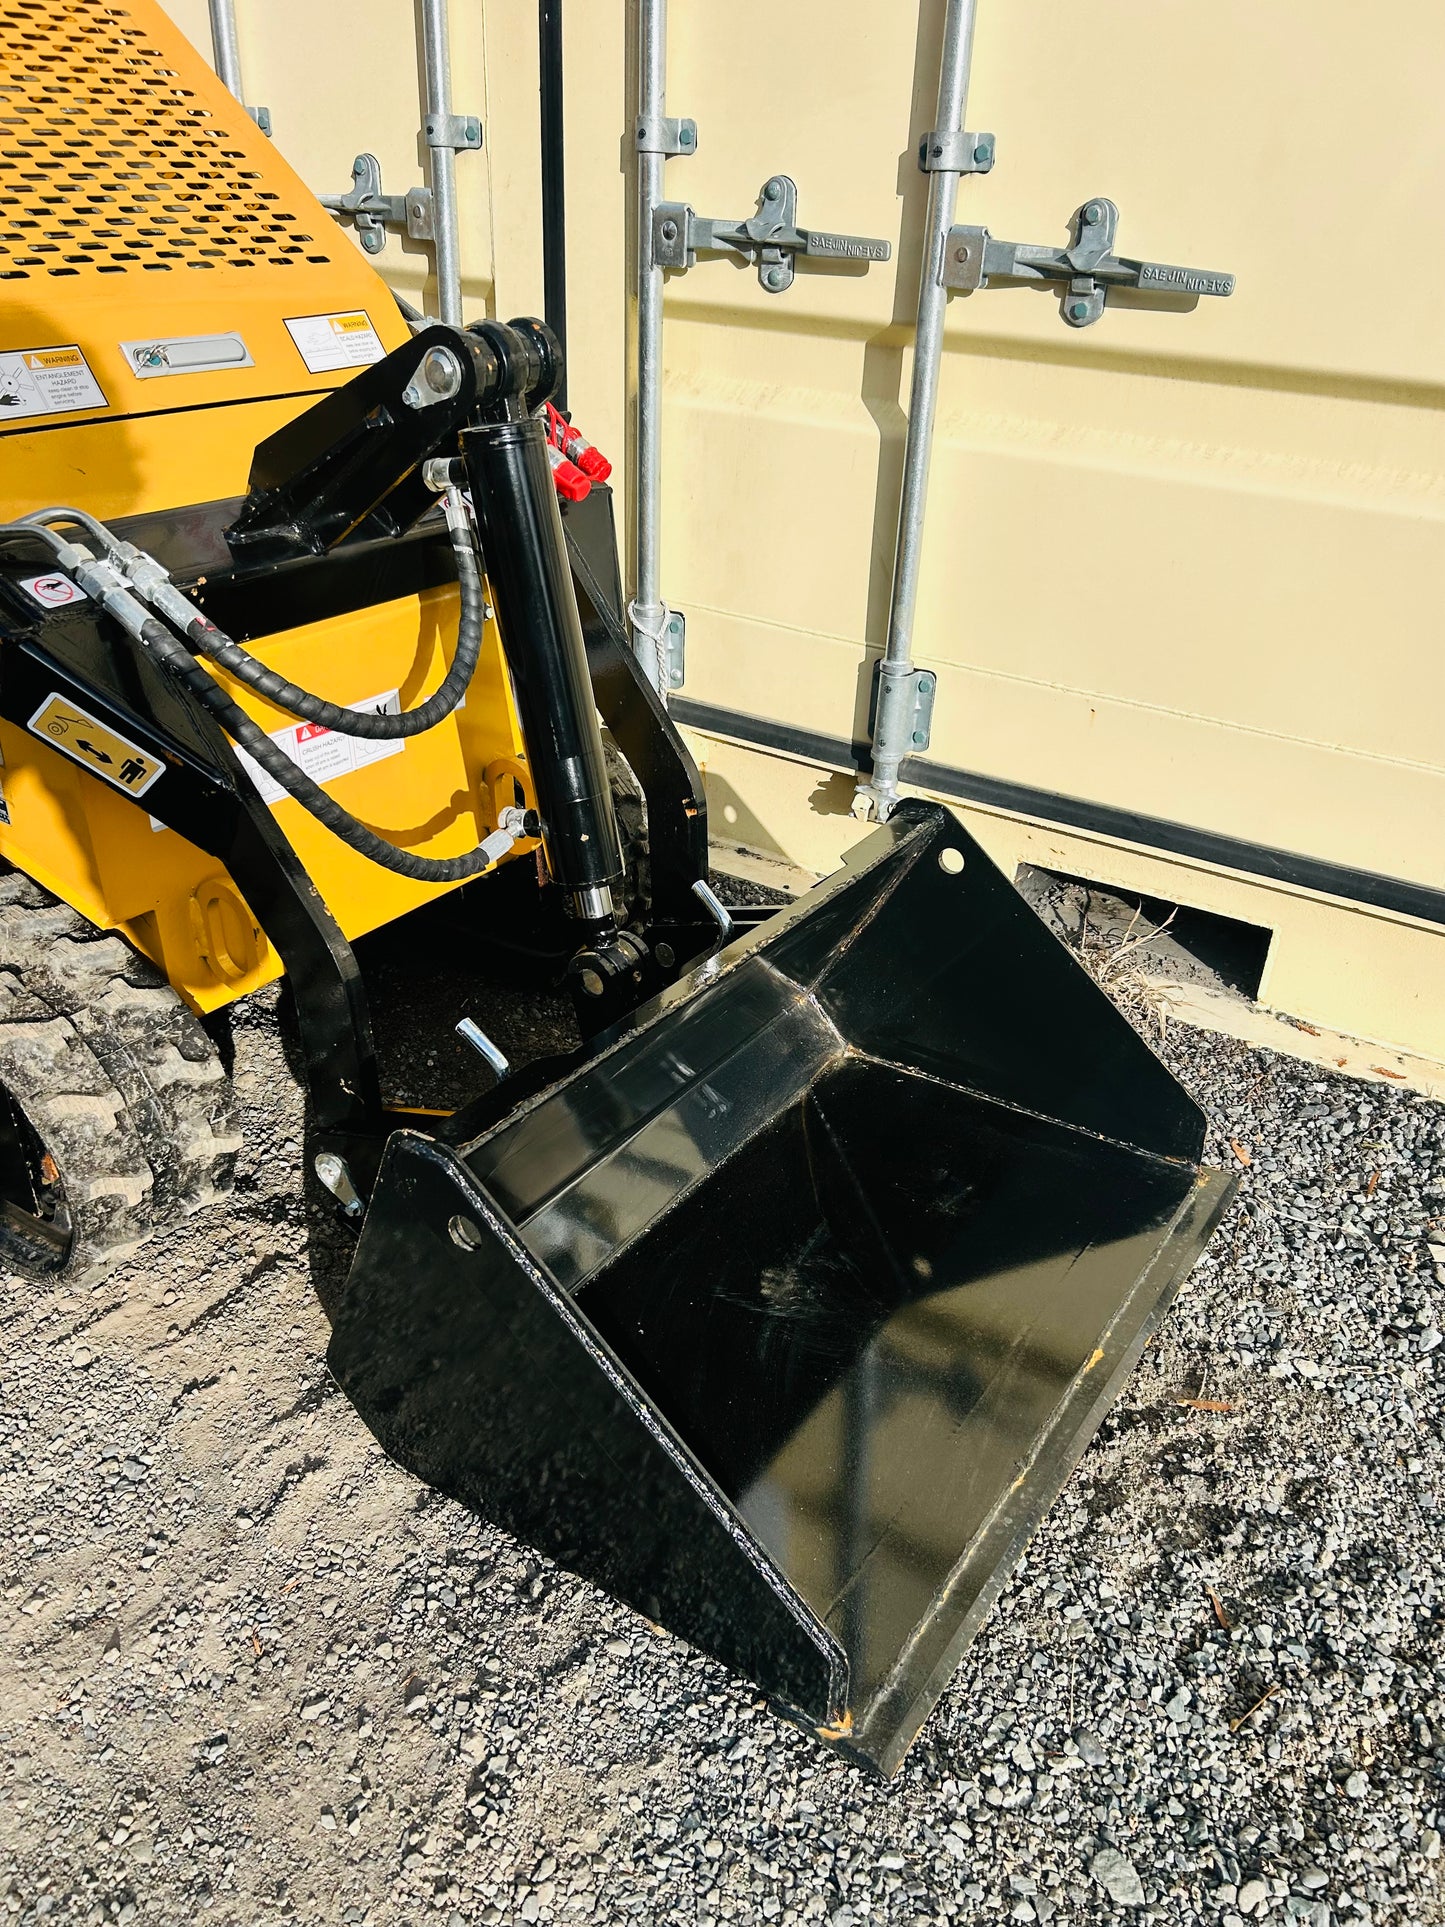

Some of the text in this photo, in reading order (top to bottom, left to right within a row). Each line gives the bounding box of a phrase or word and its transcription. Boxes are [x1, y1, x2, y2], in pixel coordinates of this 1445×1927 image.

[343, 320, 369, 329] WARNING
[43, 354, 79, 364] WARNING
[35, 370, 85, 380] ENTANGLEMENT
[51, 378, 77, 386] HAZARD
[302, 744, 321, 756] CRUSH
